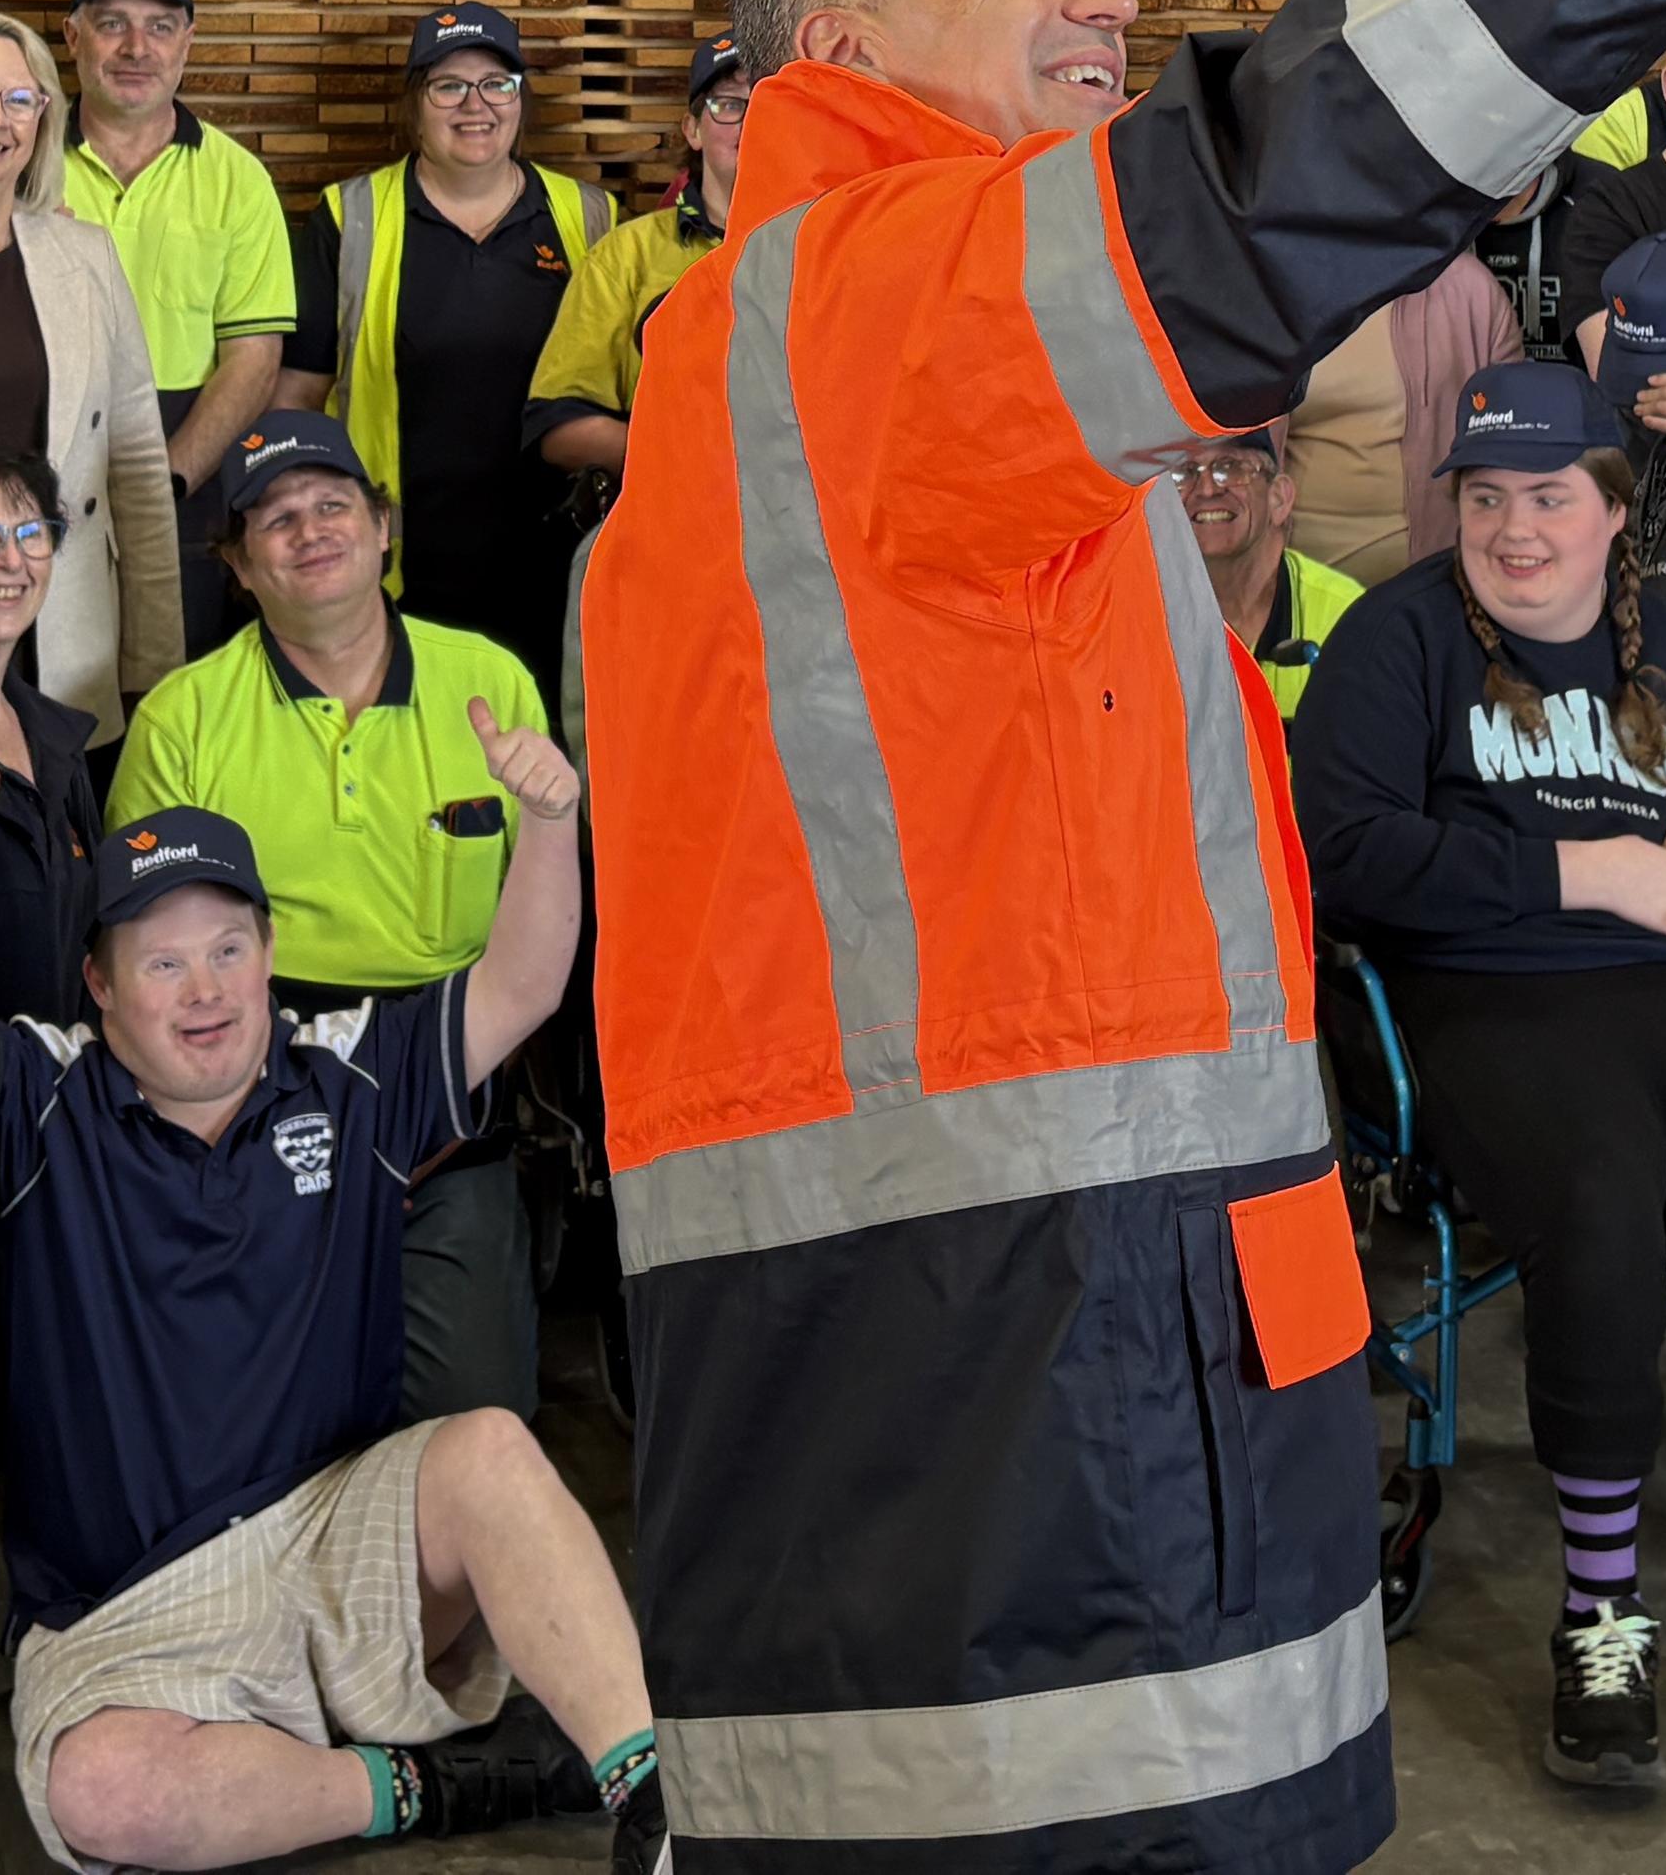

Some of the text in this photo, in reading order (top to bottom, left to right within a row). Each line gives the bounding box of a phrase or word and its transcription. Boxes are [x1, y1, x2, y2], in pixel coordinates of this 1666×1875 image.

[1468, 409, 1513, 429] Bedford
[1535, 788, 1597, 812] FRENCH
[132, 843, 199, 874] Bedford
[294, 1169, 332, 1196] CATS
